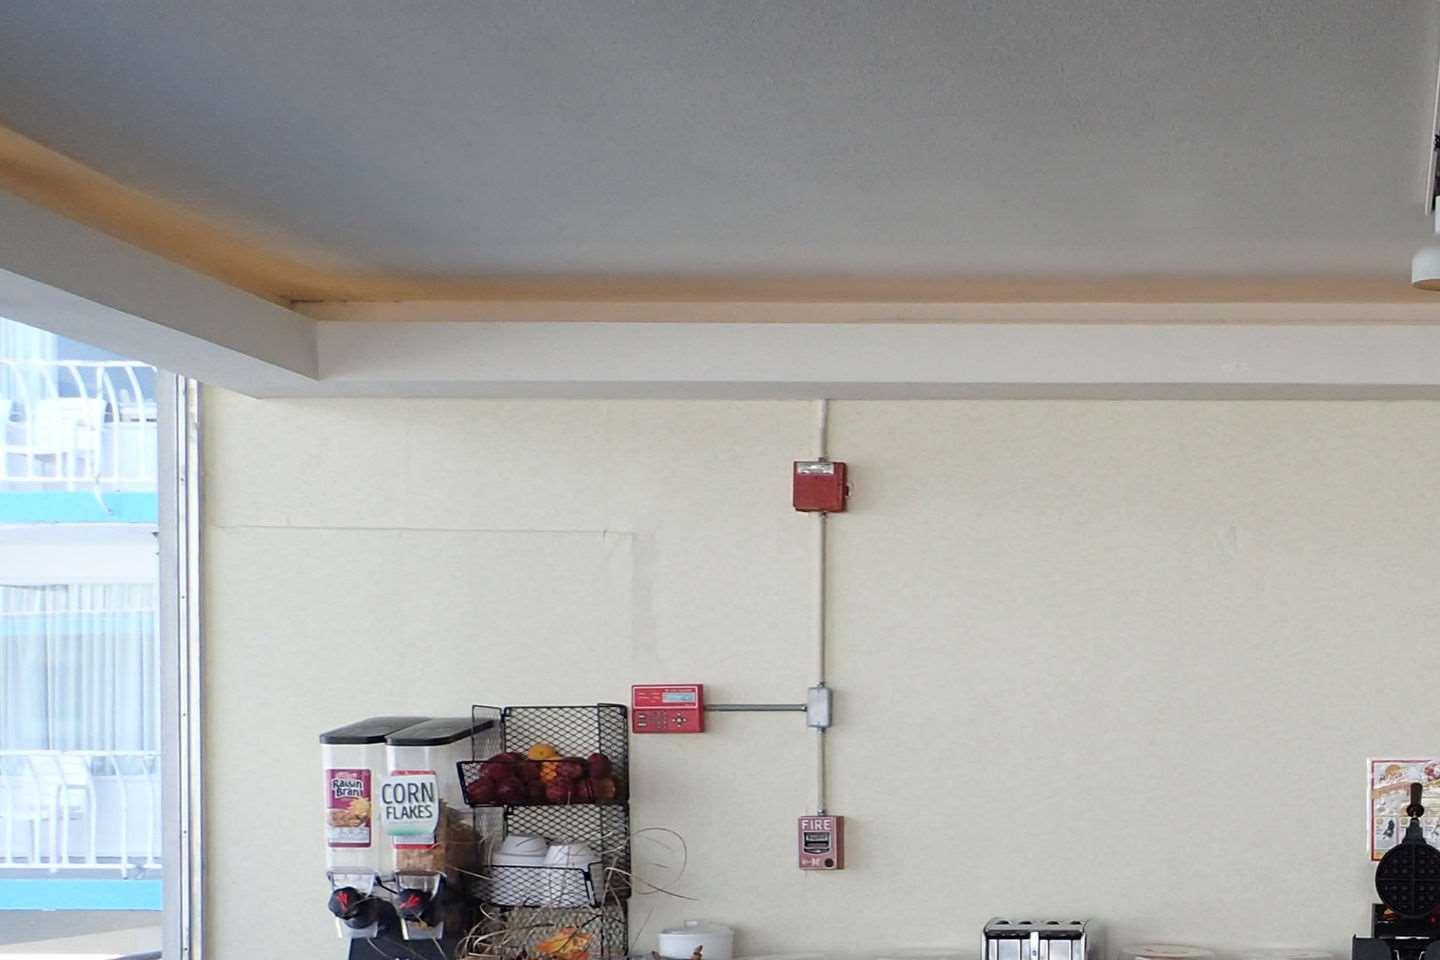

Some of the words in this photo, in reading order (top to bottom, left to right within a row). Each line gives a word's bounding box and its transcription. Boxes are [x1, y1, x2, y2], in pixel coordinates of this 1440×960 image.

[332, 779, 363, 790] Raisin
[336, 788, 362, 797] Bran
[381, 782, 434, 805] CORN
[385, 804, 433, 820] FLAKES
[801, 819, 832, 831] FIRE
